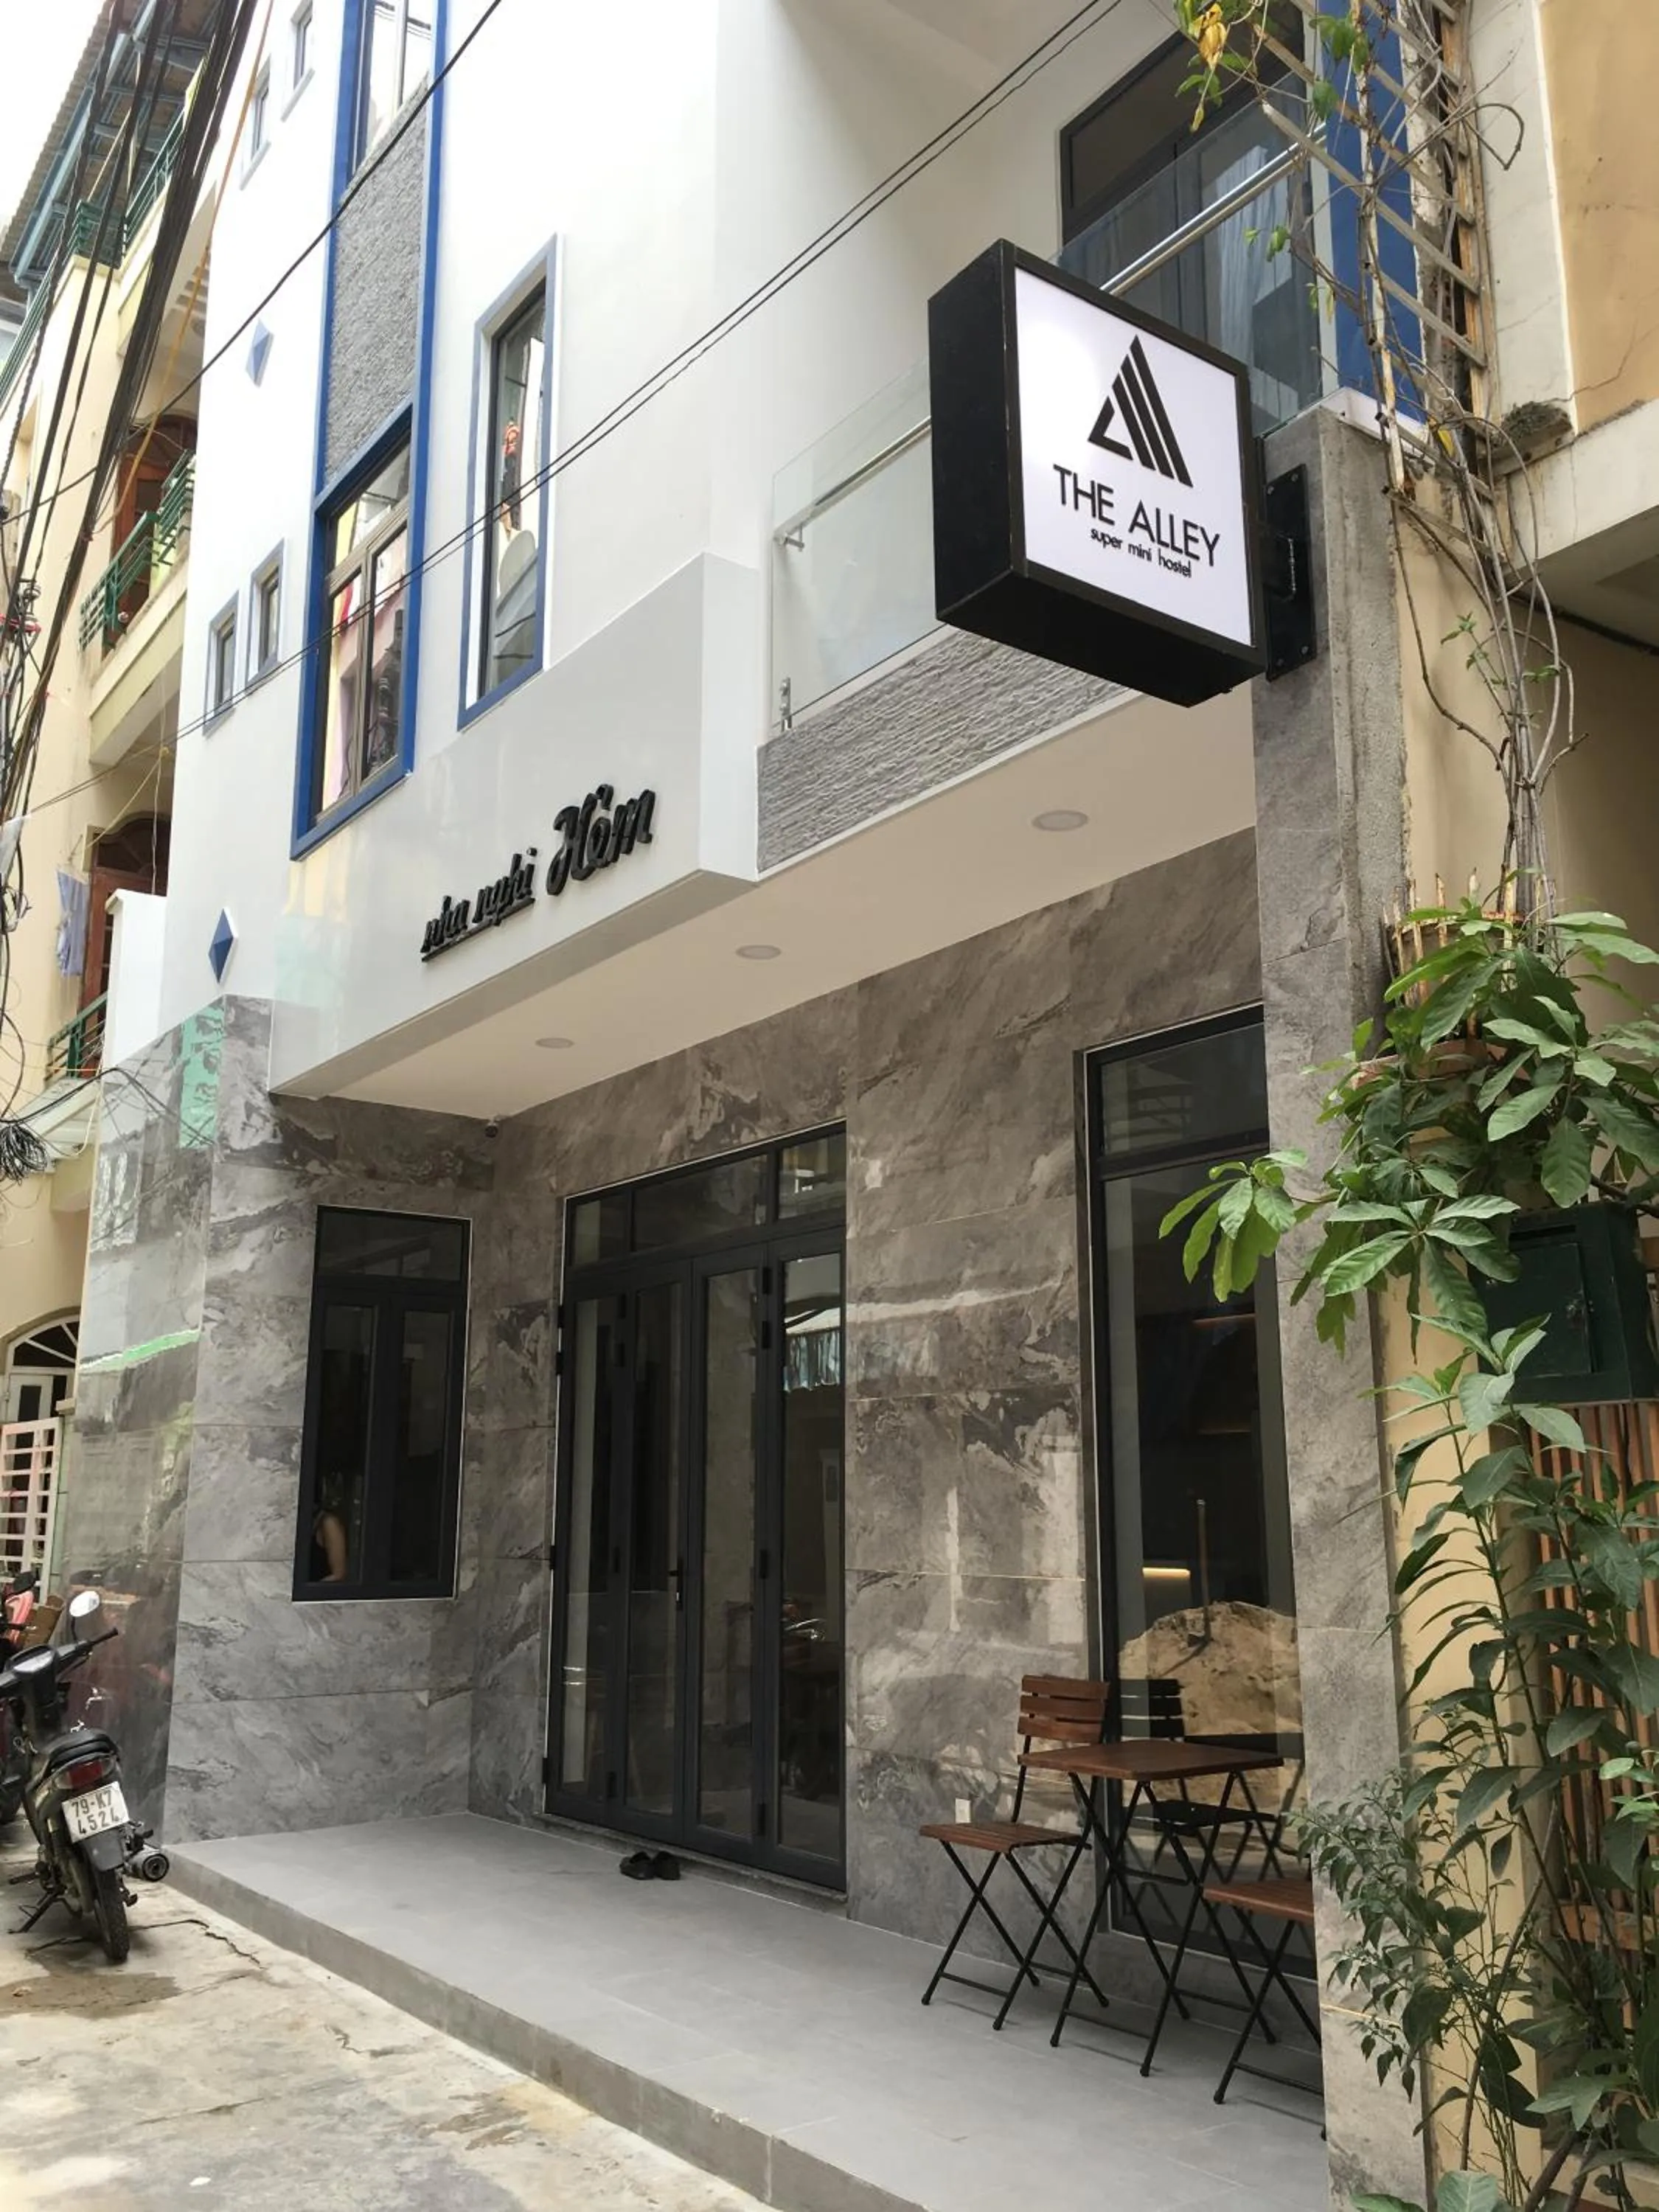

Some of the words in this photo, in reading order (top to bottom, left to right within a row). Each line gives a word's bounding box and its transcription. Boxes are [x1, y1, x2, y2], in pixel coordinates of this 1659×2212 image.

[1053, 464, 1115, 526] THE
[1128, 499, 1220, 566] ALLEY
[1091, 528, 1123, 549] super
[1127, 543, 1152, 562] mini
[1158, 548, 1192, 577] hostel
[72, 1790, 112, 1818] 79-K7
[77, 1808, 119, 1835] 4524
